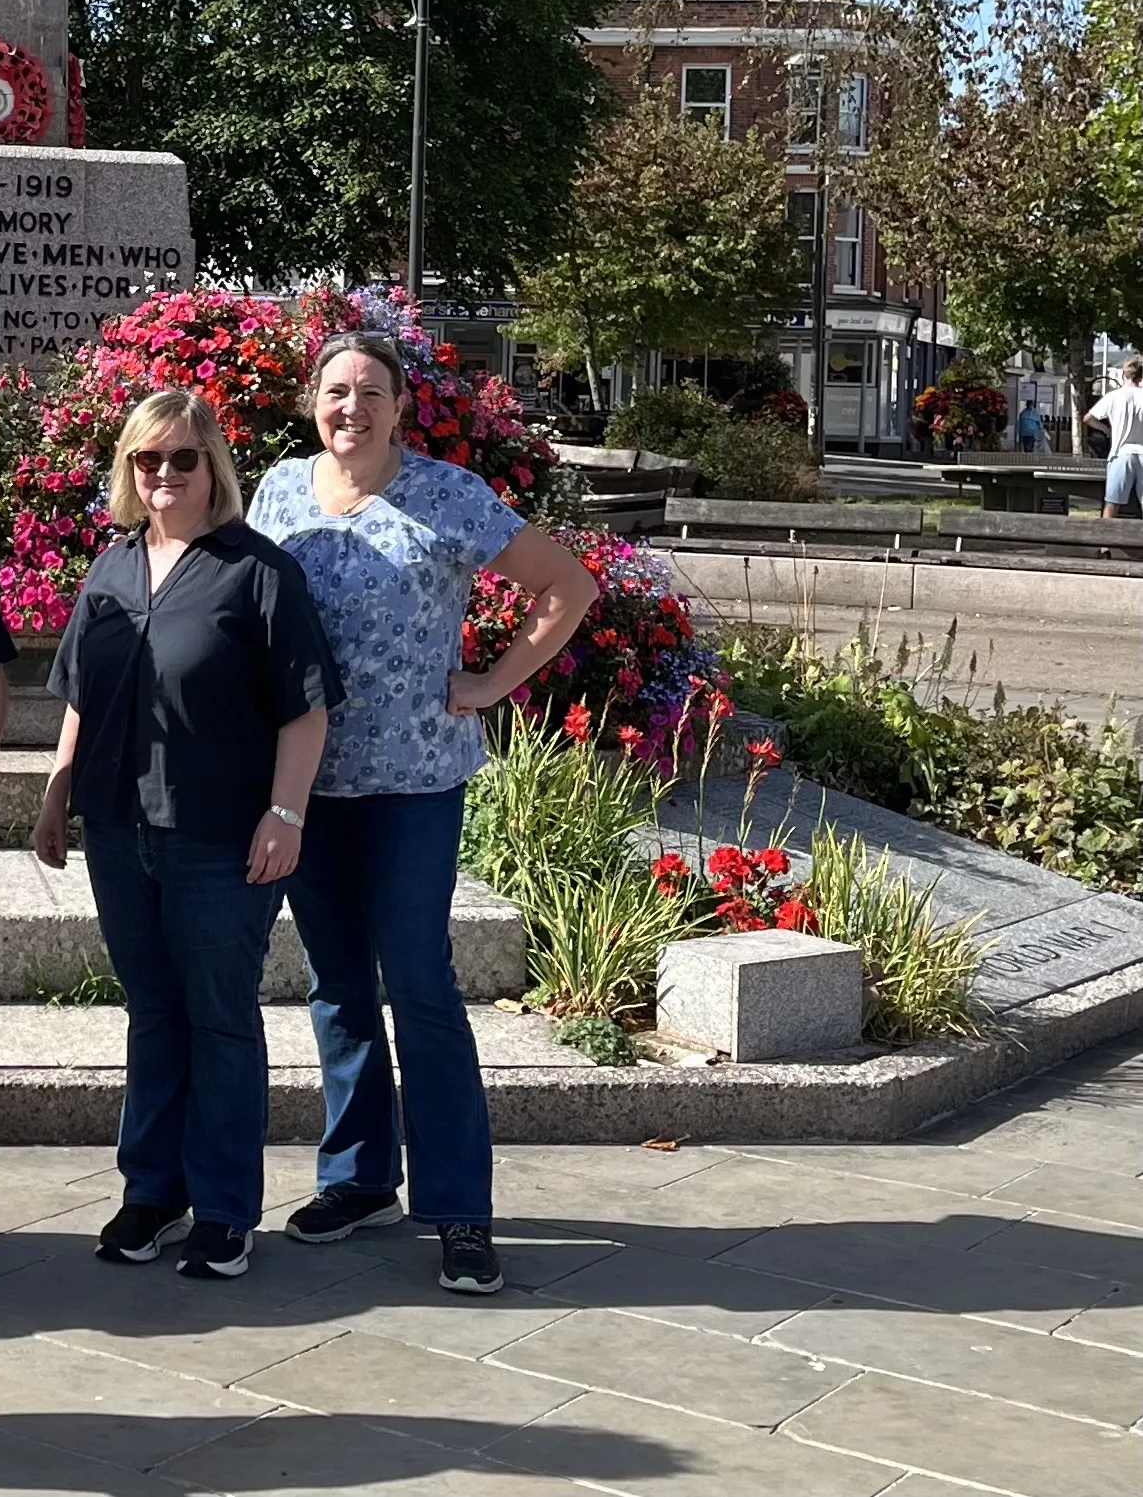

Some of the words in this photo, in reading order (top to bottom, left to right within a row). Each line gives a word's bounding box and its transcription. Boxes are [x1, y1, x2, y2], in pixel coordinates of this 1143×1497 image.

[17, 174, 73, 198] 1919
[43, 244, 103, 266] MEN
[120, 246, 181, 268] WHO
[82, 277, 130, 299] FOR
[49, 311, 81, 330] TO
[1039, 927, 1113, 951] WAR
